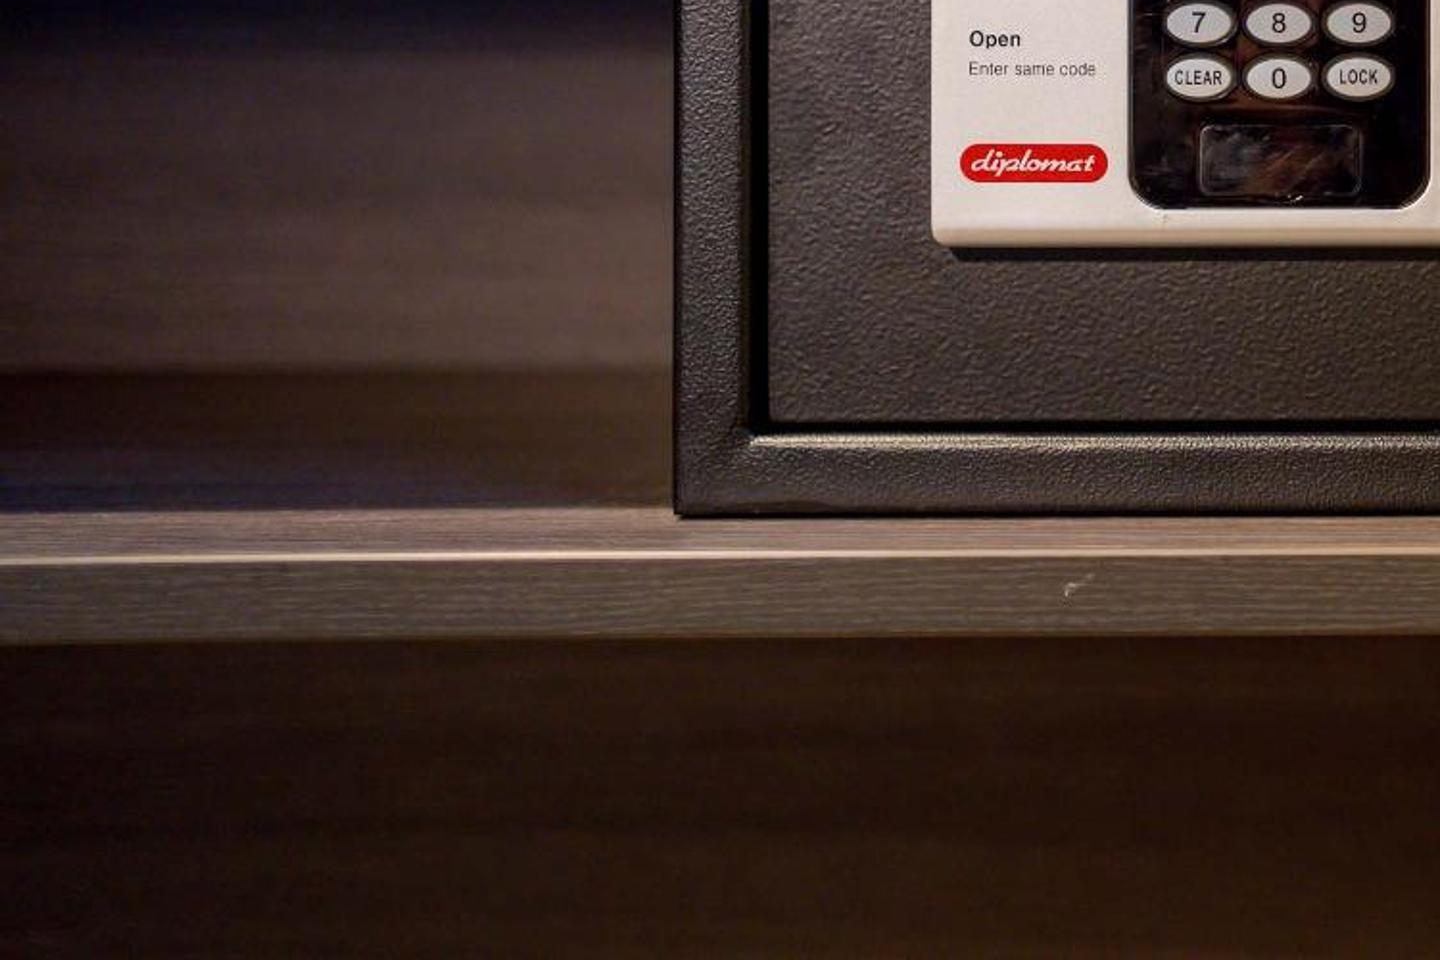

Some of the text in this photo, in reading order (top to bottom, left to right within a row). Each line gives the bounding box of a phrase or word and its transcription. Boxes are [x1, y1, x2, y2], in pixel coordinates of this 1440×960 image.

[1192, 12, 1206, 33] 7
[1272, 12, 1286, 33] 8
[1352, 12, 1366, 33] 9
[969, 30, 1021, 49] Open
[969, 61, 1096, 76] Enter same code
[1174, 70, 1223, 86] CLEAR
[1272, 68, 1286, 89] 0
[1339, 69, 1378, 86] LOCK
[971, 149, 1096, 177] diplomat
